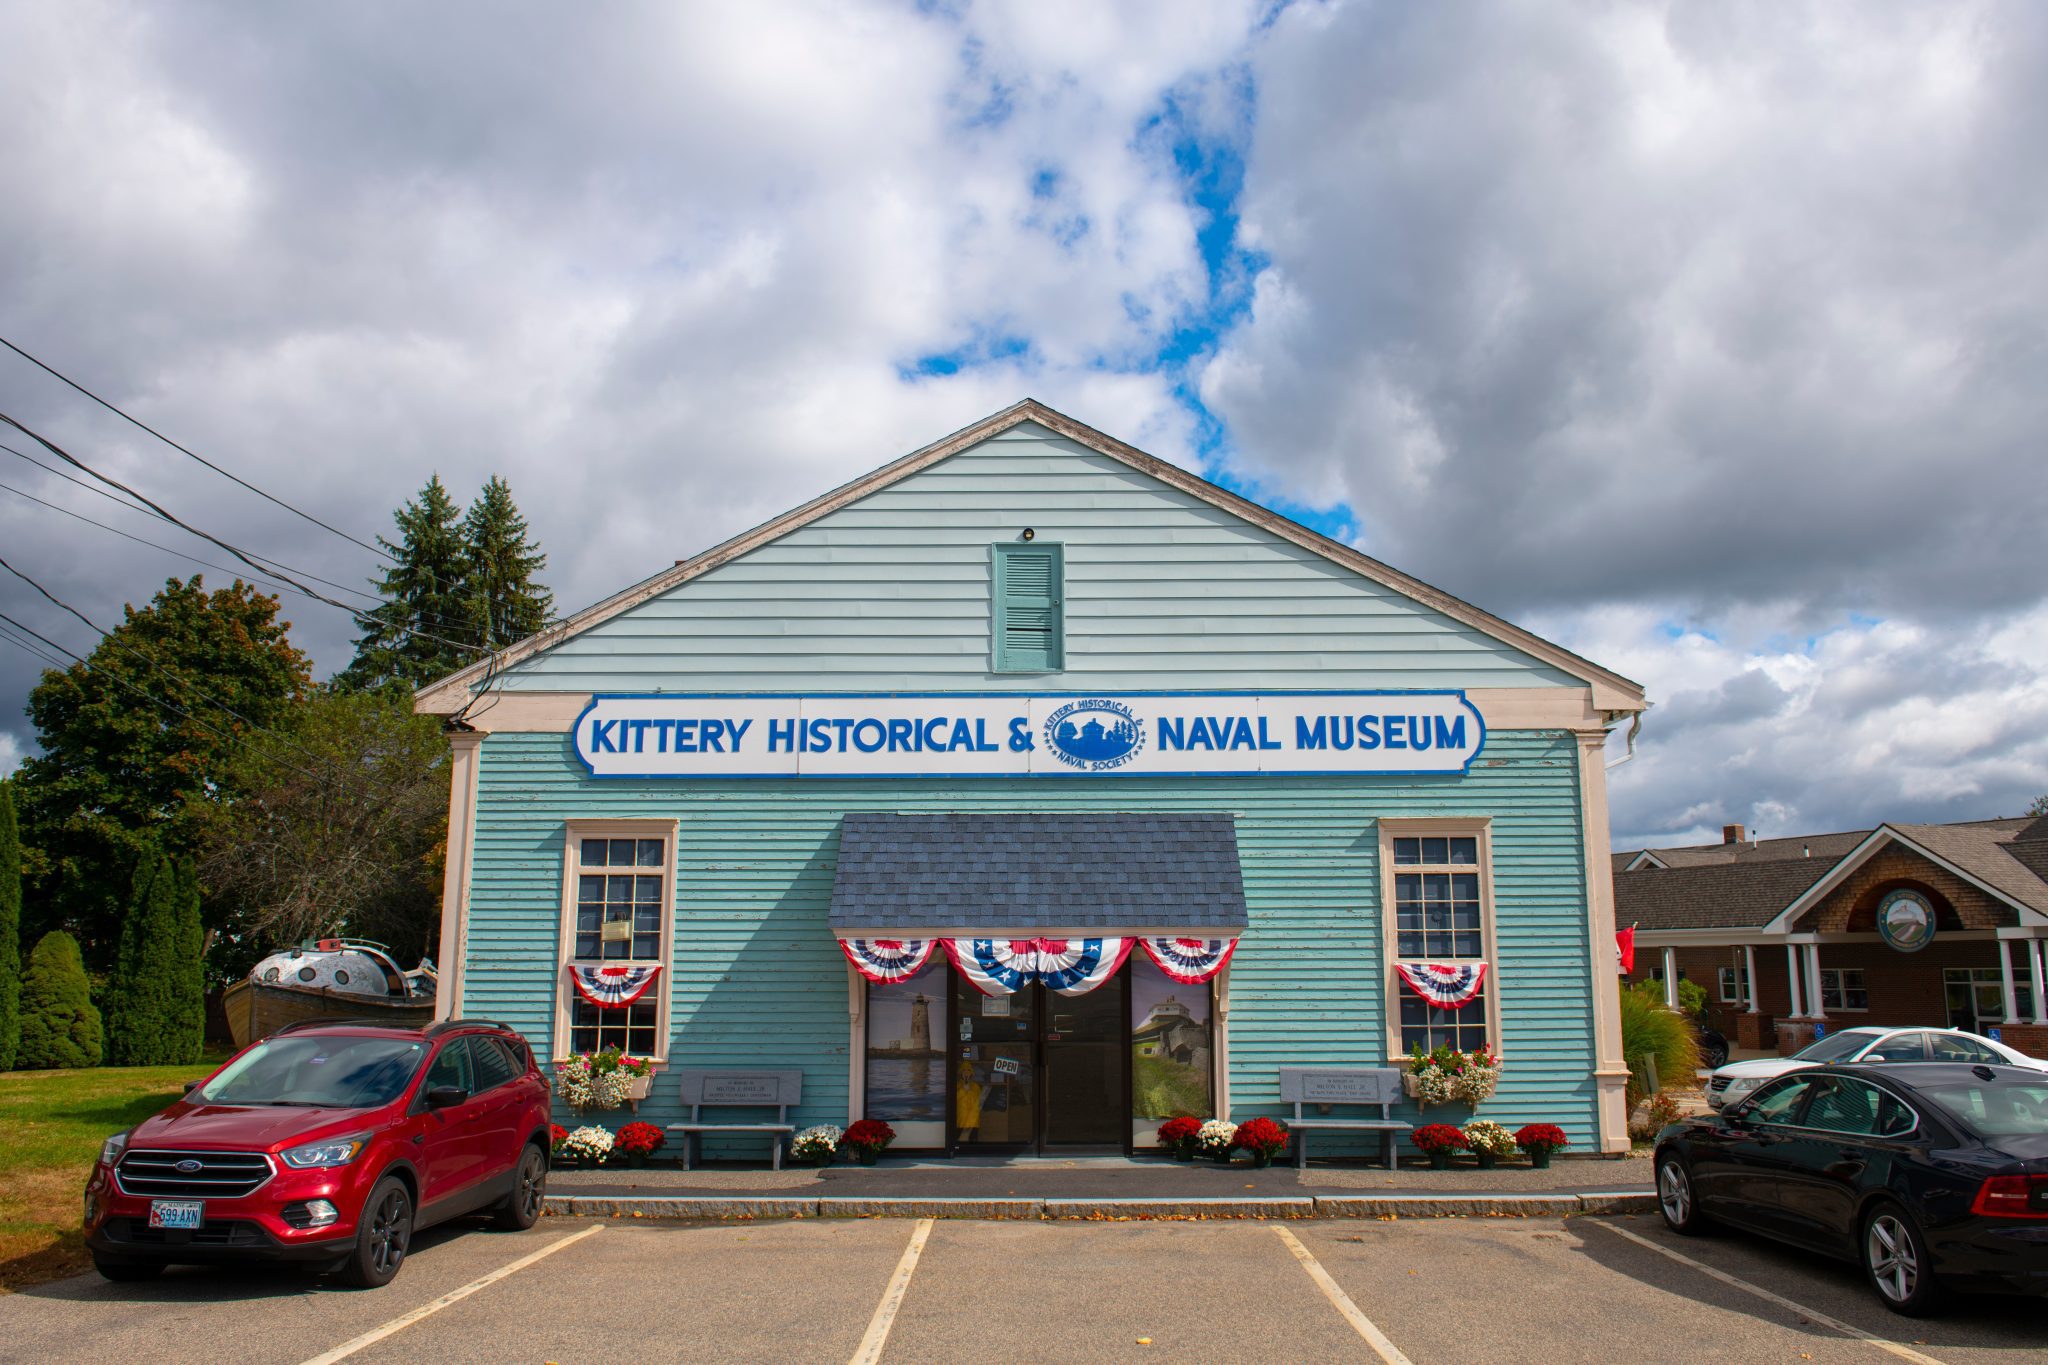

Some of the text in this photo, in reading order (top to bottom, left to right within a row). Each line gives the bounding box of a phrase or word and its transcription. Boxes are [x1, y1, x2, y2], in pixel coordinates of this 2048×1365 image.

[1043, 702, 1075, 731] KITTERY
[1078, 699, 1133, 717] HISTORICAL
[591, 714, 1467, 753] KITTERY HISTORICAL & NAVAL MUSEUM
[1056, 751, 1133, 771] NAVAL SOCIETY
[996, 1059, 1017, 1072] OPEN
